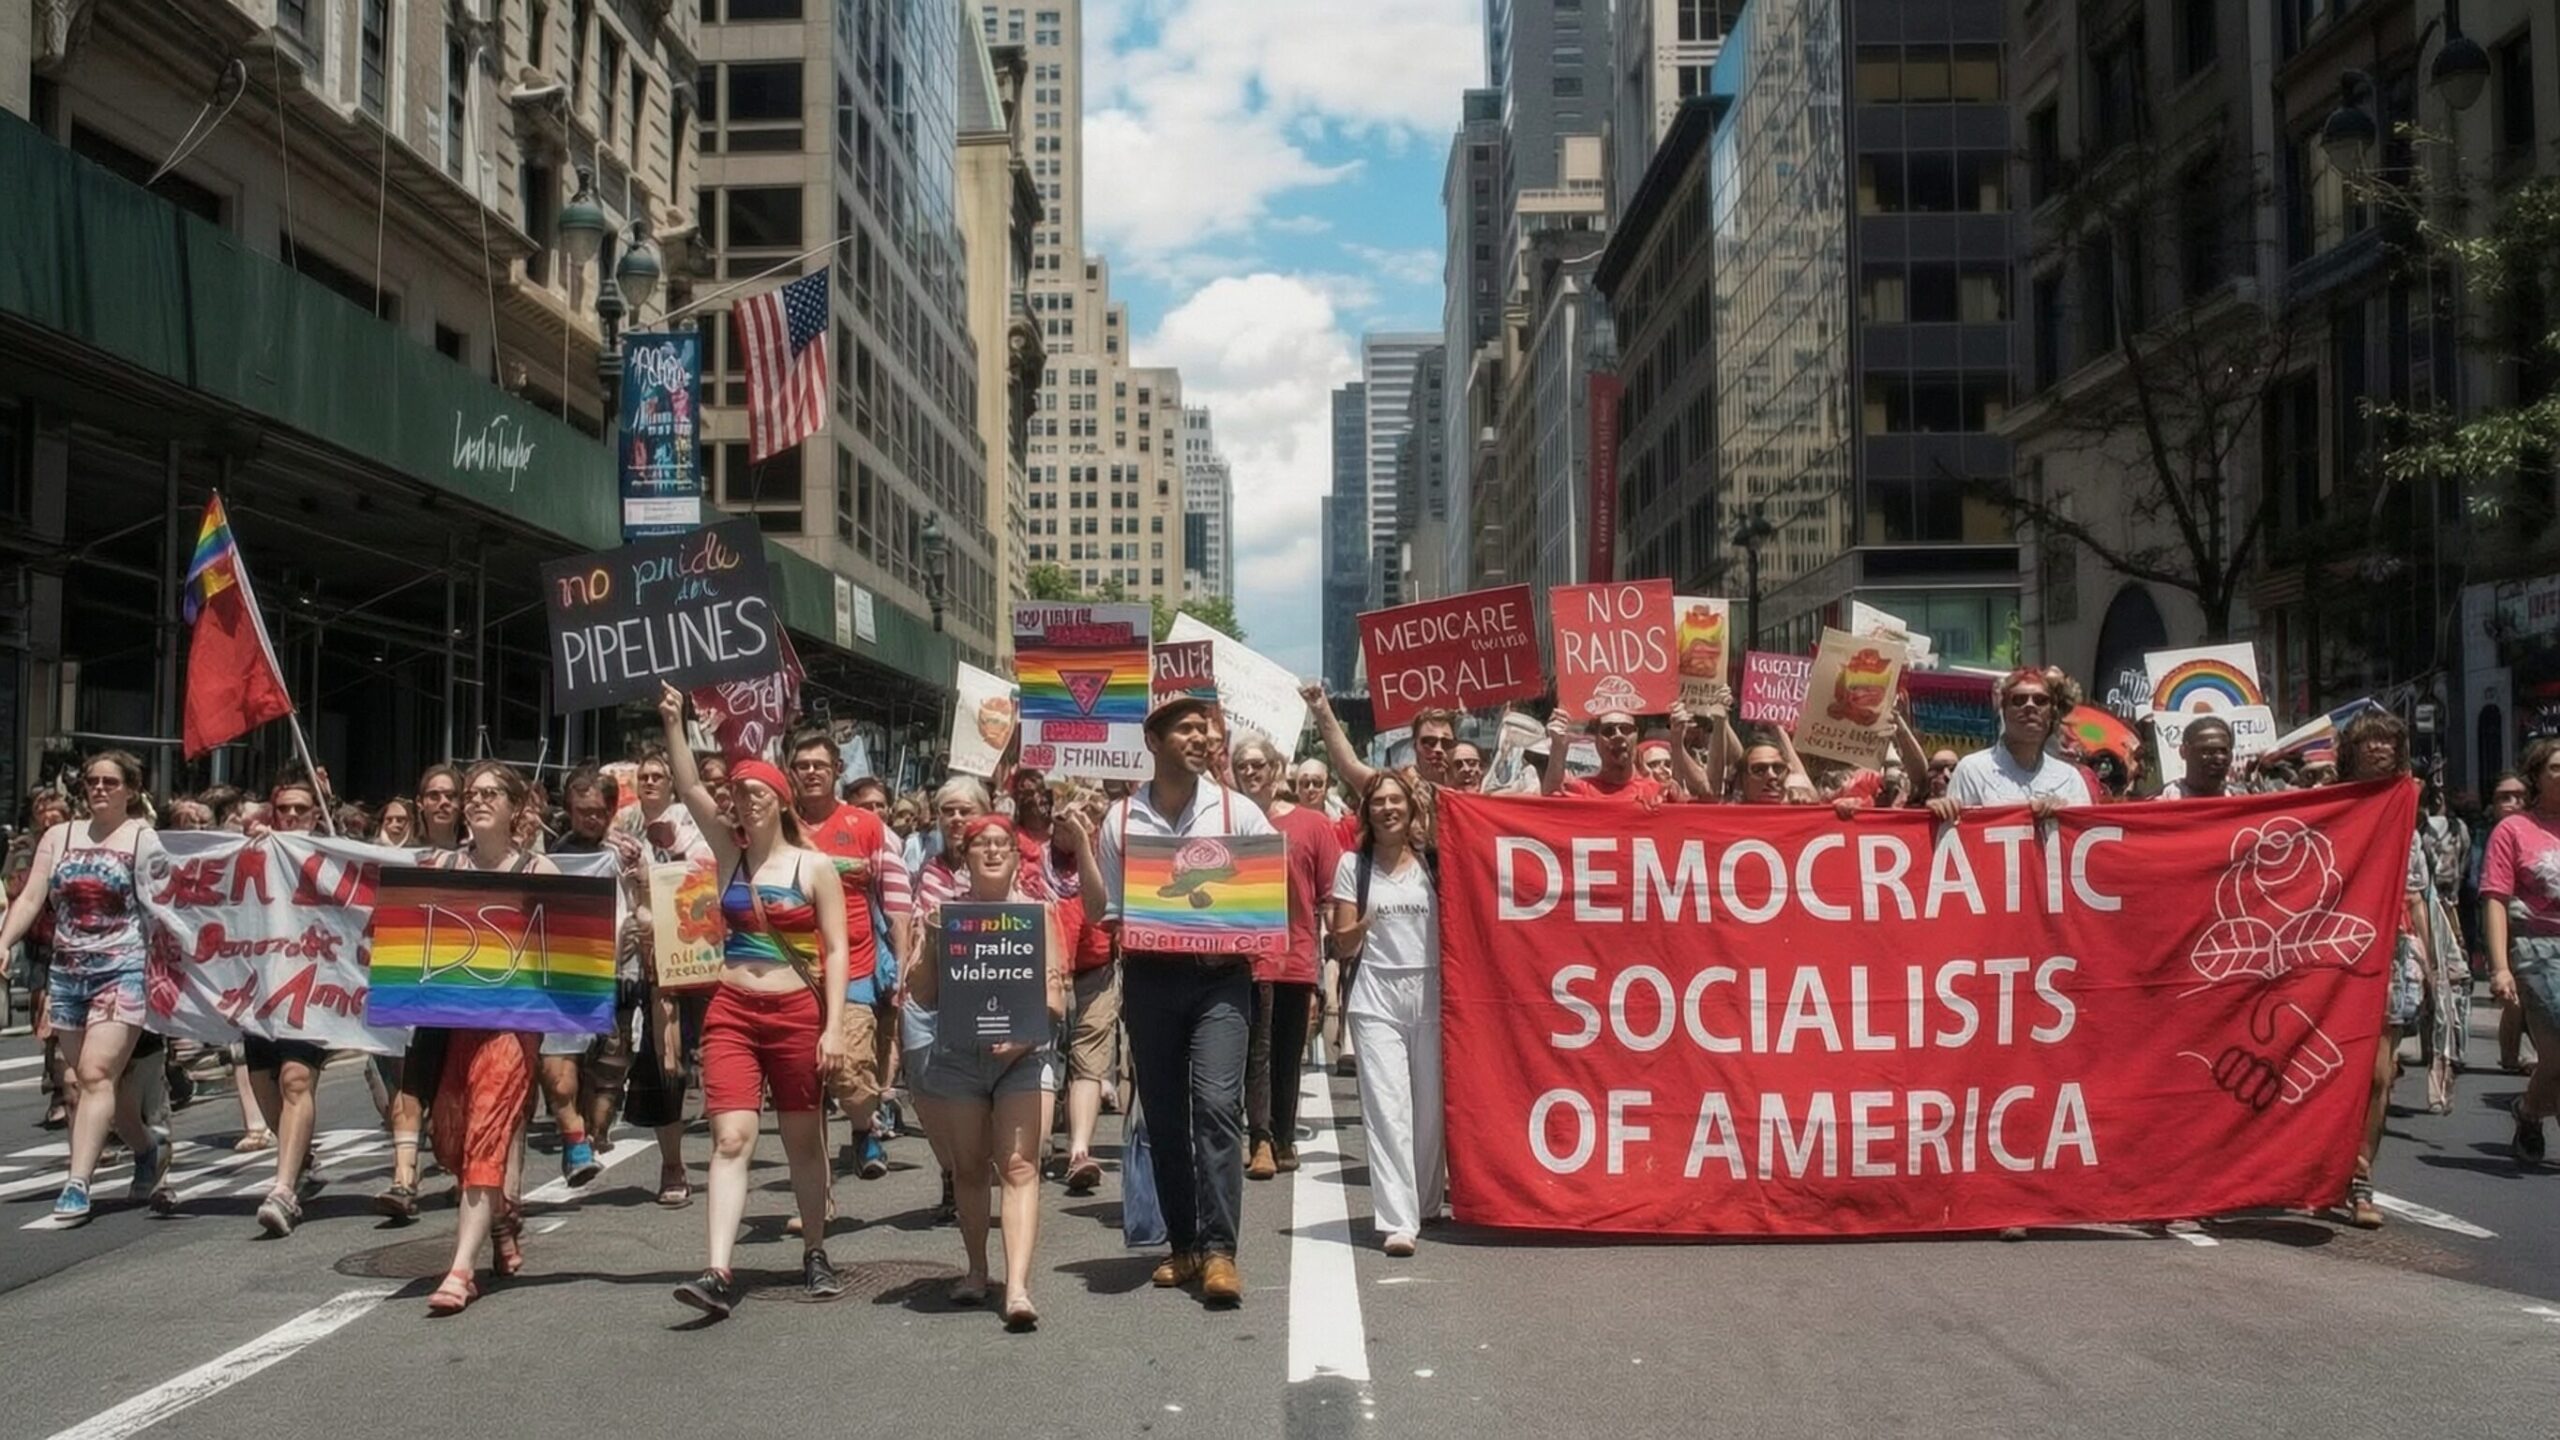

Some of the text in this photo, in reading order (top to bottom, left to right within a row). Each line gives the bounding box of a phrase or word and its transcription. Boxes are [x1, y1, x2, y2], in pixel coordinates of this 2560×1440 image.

[558, 569, 610, 607] no
[1588, 585, 1643, 623] NO
[562, 596, 767, 690] PIPELINES
[1374, 602, 1518, 655] MEDICARE
[1561, 626, 1667, 675] RAIDS
[1380, 653, 1522, 706] FOR ALL
[1495, 826, 2124, 922] DEMOCRATIC
[418, 904, 549, 986] DSA
[1549, 955, 2078, 1053] SOCIALISTS
[1527, 1082, 2100, 1180] OF AMERICA
